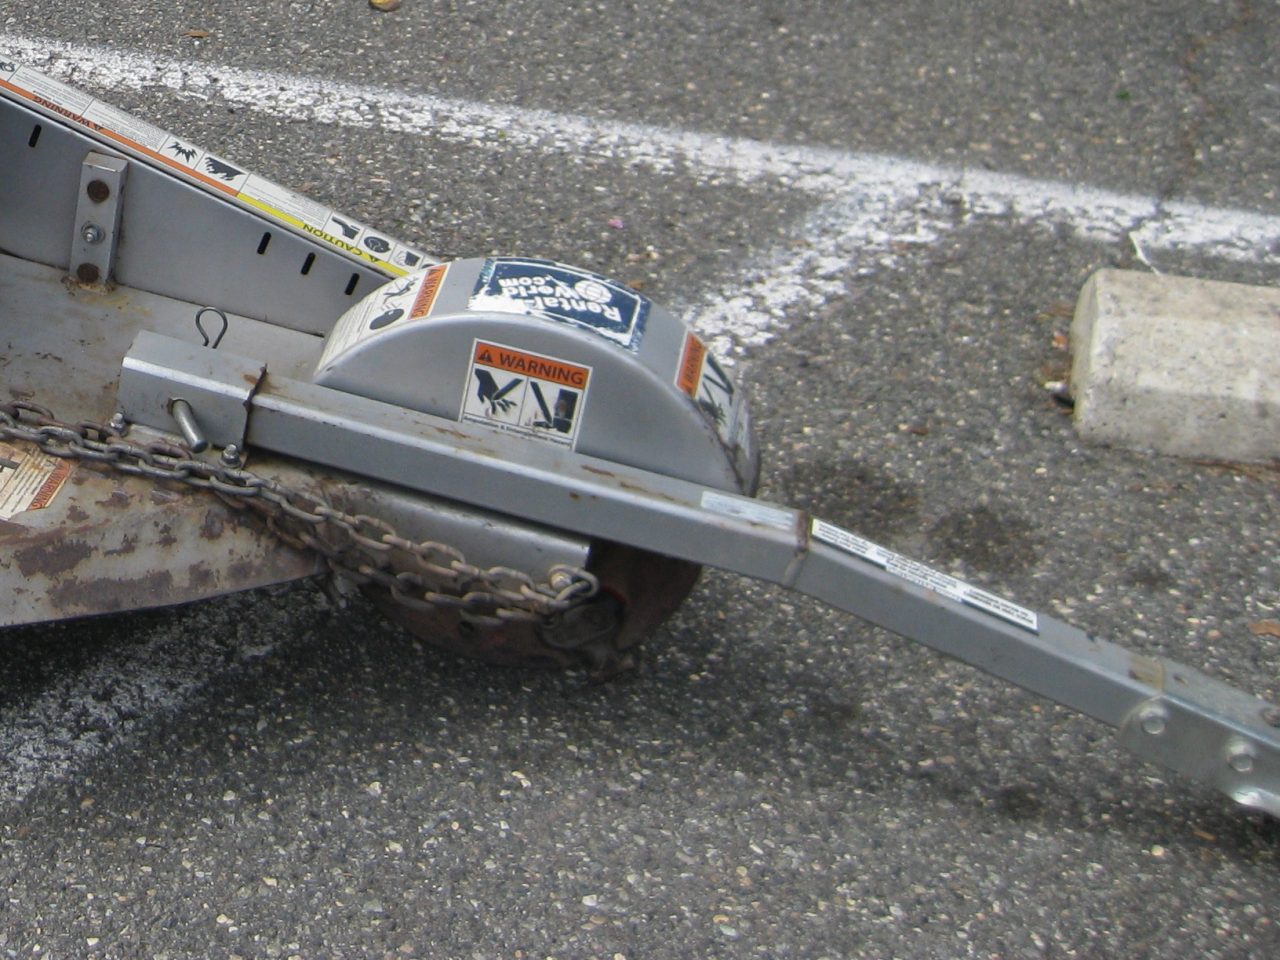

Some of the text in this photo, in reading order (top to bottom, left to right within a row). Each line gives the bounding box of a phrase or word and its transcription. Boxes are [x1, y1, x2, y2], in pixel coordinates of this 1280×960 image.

[33, 96, 90, 127] WARNING
[302, 223, 363, 257] CAUTION
[501, 284, 580, 301] World
[499, 349, 584, 385] WARNING
